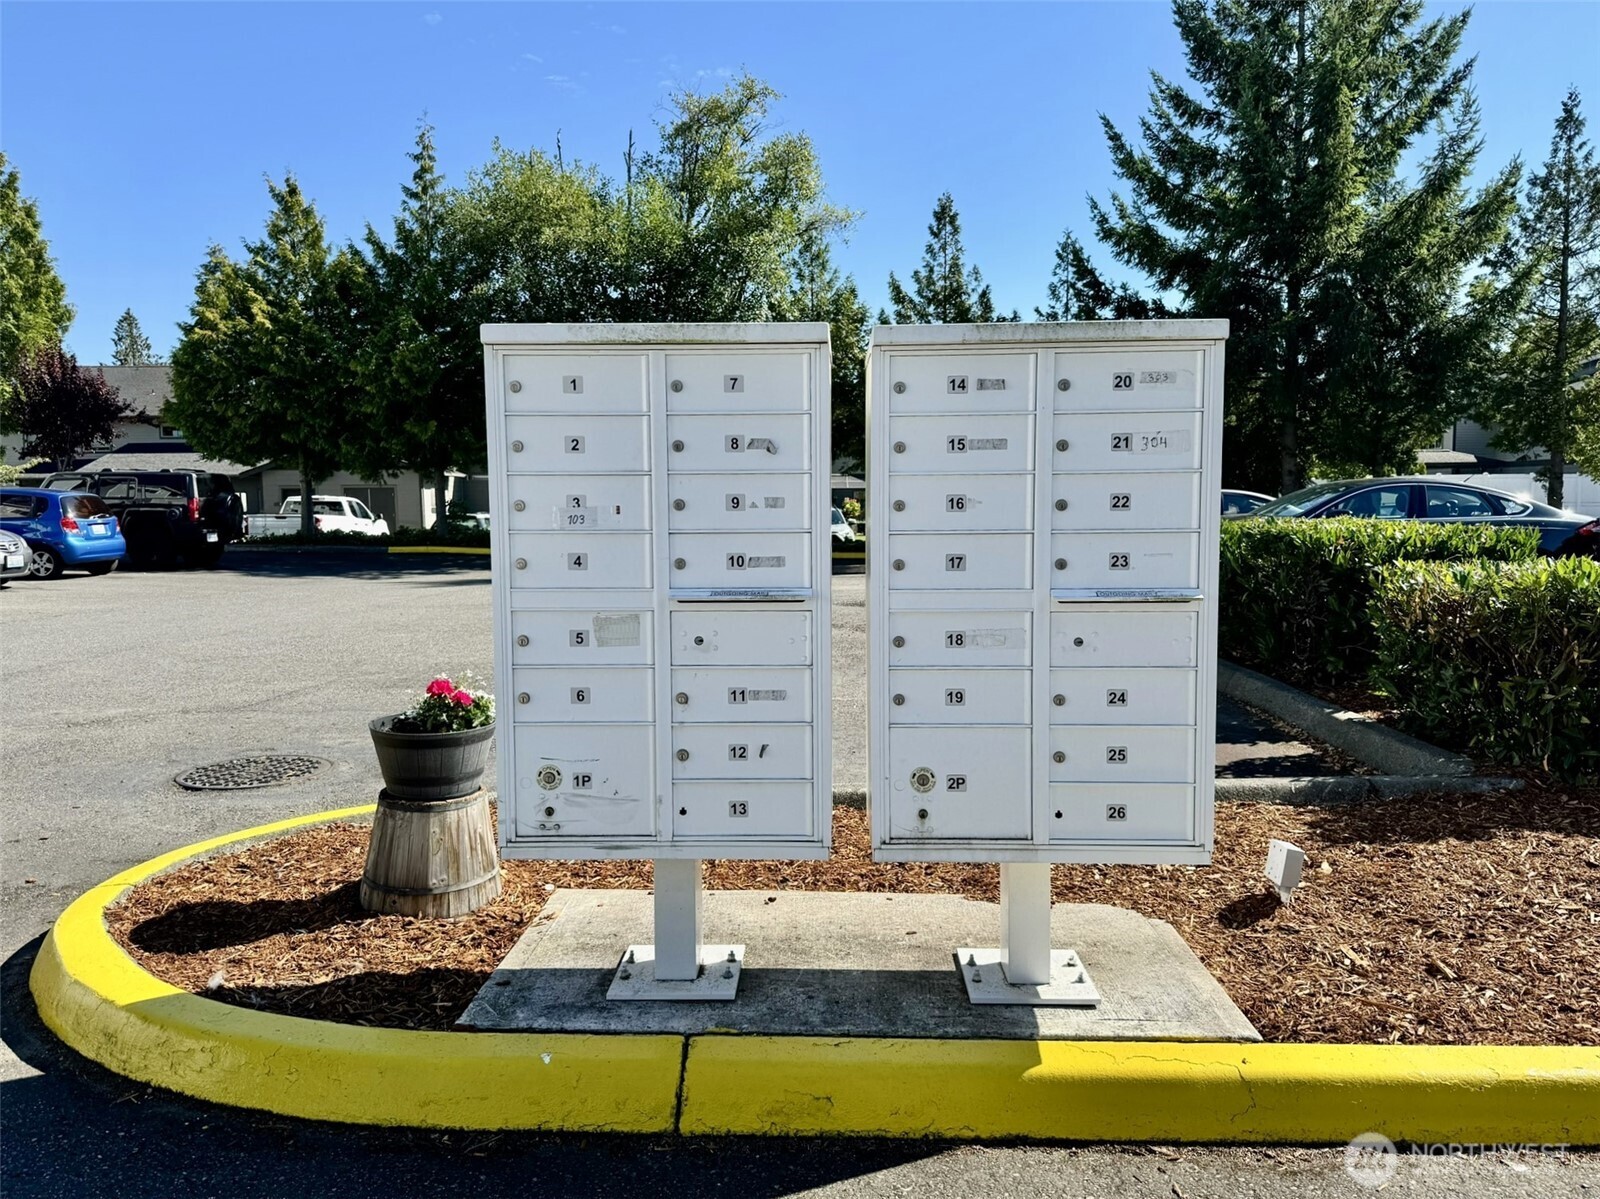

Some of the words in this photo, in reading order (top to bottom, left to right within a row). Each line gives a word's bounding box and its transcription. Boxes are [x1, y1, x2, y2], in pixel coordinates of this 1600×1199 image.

[570, 378, 577, 391] 1
[729, 377, 739, 391] 7
[949, 378, 967, 392] 14
[1113, 375, 1133, 389] 20
[570, 438, 580, 452] 2
[730, 437, 739, 450] 8
[948, 438, 966, 451] 15
[1112, 435, 1129, 449] 21
[1141, 434, 1167, 450] 304
[571, 496, 581, 508] 3
[731, 496, 740, 510] 9
[948, 497, 965, 510] 16
[1111, 495, 1130, 509] 22
[566, 514, 586, 525] 103
[573, 555, 583, 568] 4
[728, 555, 745, 568] 10
[948, 556, 964, 569] 17
[1110, 554, 1129, 568] 23
[575, 632, 584, 645] 5
[947, 633, 964, 646] 18
[576, 689, 585, 702] 6
[730, 689, 746, 702] 11
[947, 691, 964, 704] 19
[1108, 691, 1127, 705] 24
[730, 746, 747, 759] 12
[1108, 748, 1126, 762] 25
[573, 774, 592, 788] 1P
[947, 777, 966, 790] 2P
[730, 802, 747, 816] 13
[1108, 806, 1126, 820] 26
